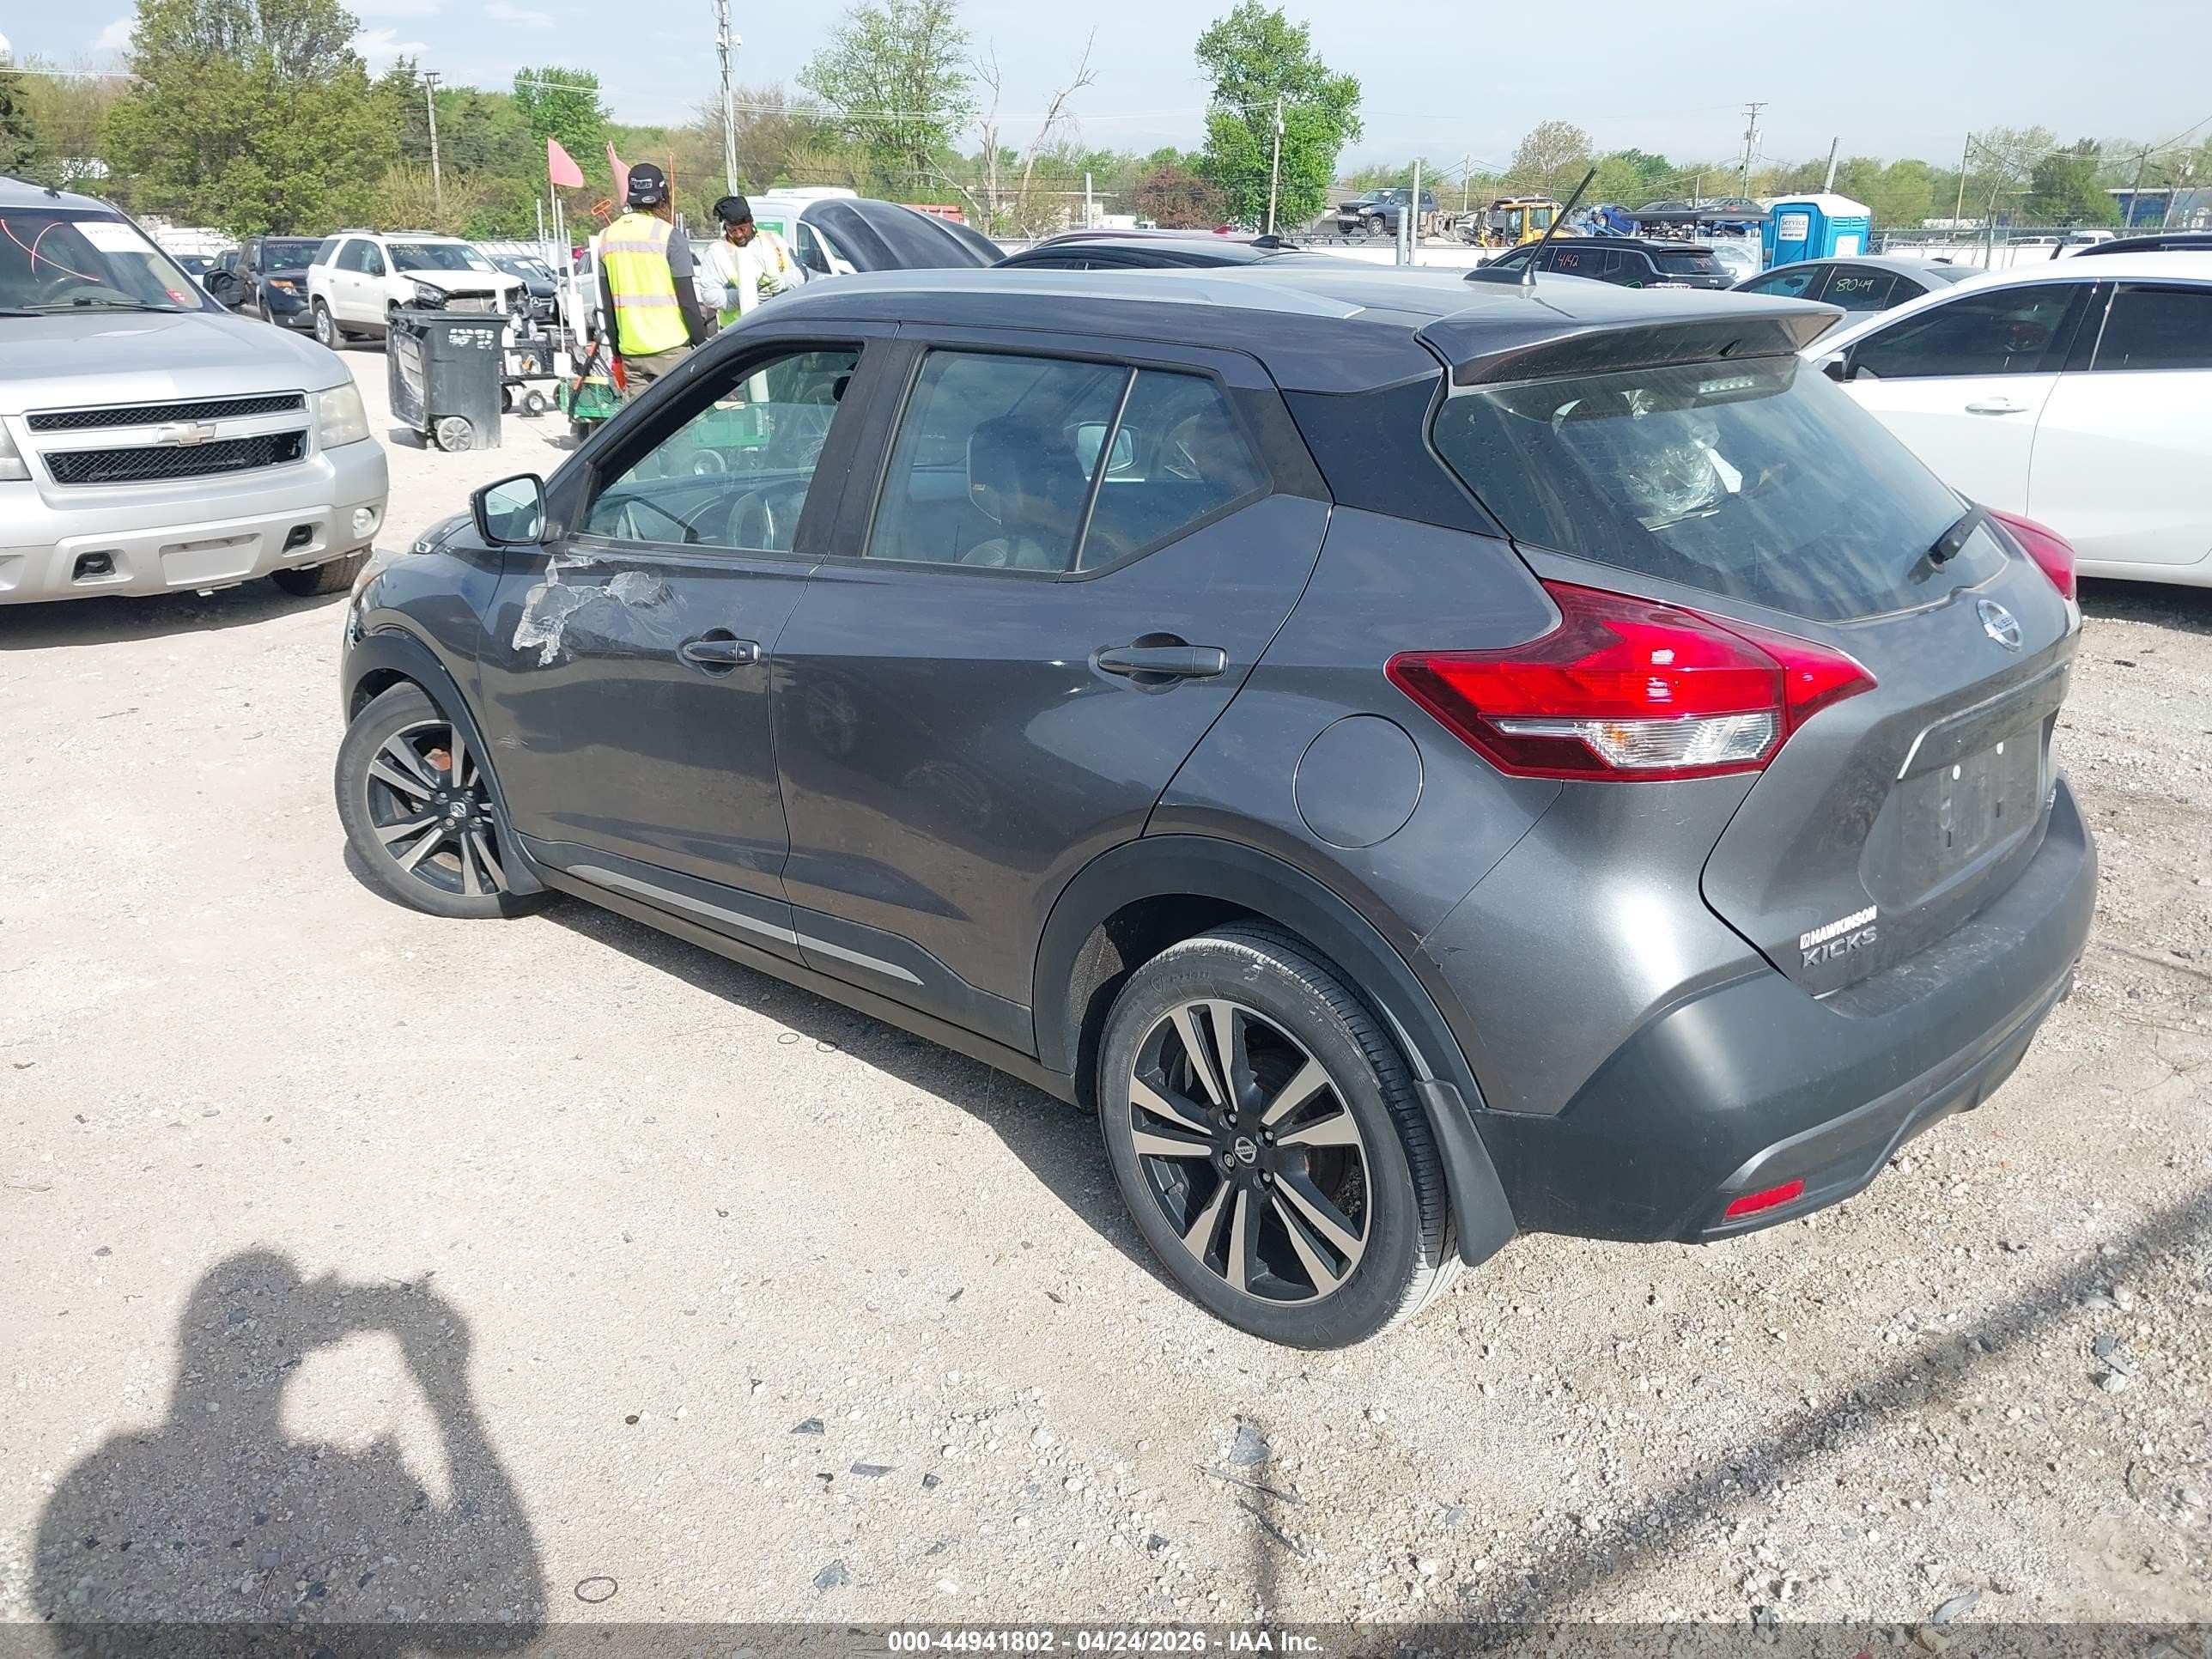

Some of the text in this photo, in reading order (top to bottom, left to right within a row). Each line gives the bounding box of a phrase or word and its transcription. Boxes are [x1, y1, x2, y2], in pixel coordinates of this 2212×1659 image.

[1836, 278, 1875, 292] 8049
[1810, 904, 1877, 945] HAWKINSON
[1801, 926, 1877, 969] KICKS
